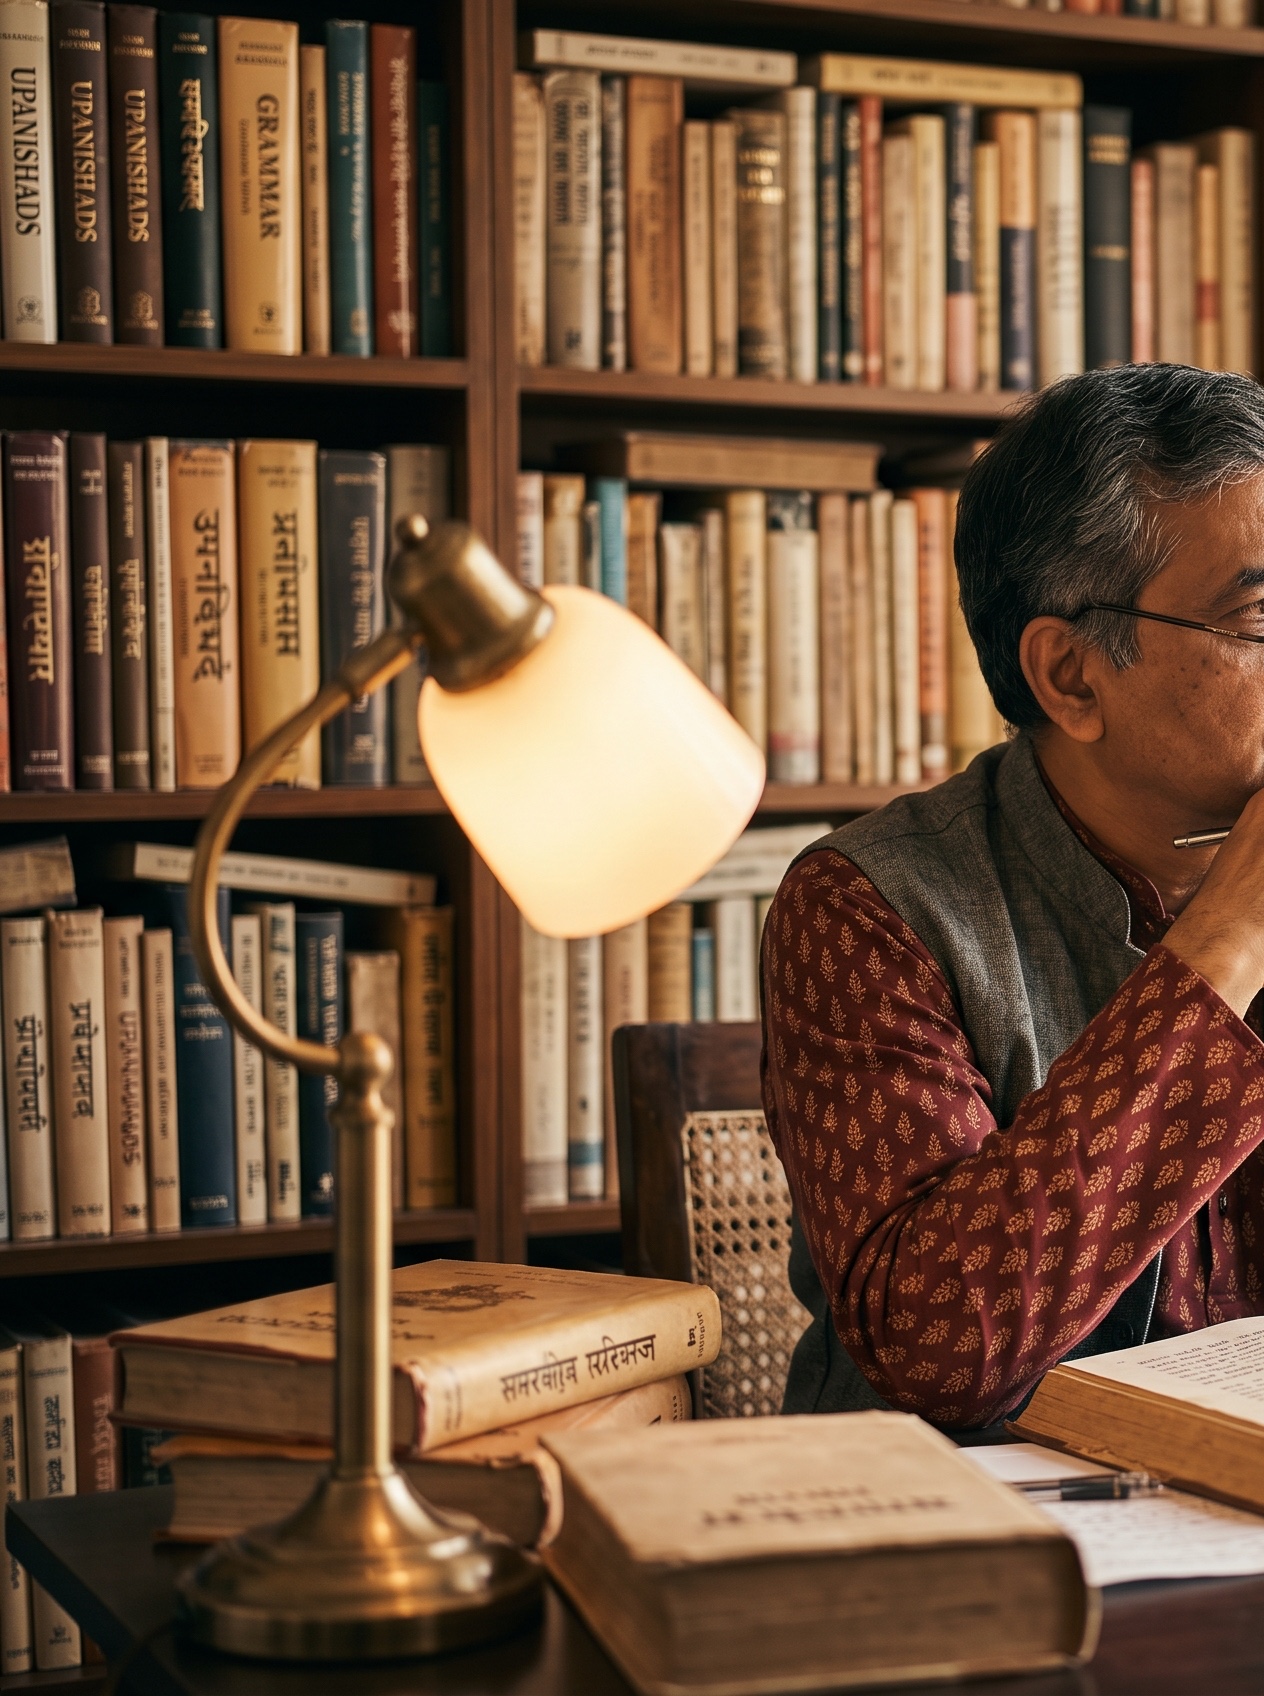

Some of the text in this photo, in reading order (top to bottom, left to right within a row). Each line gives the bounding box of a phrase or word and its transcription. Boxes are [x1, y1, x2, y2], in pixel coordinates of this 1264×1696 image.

[10, 66, 41, 236] UPANISHADS
[70, 80, 98, 243] UPANISHADS
[124, 88, 150, 243] UPANISHADS
[256, 92, 282, 241] GRAMMAR
